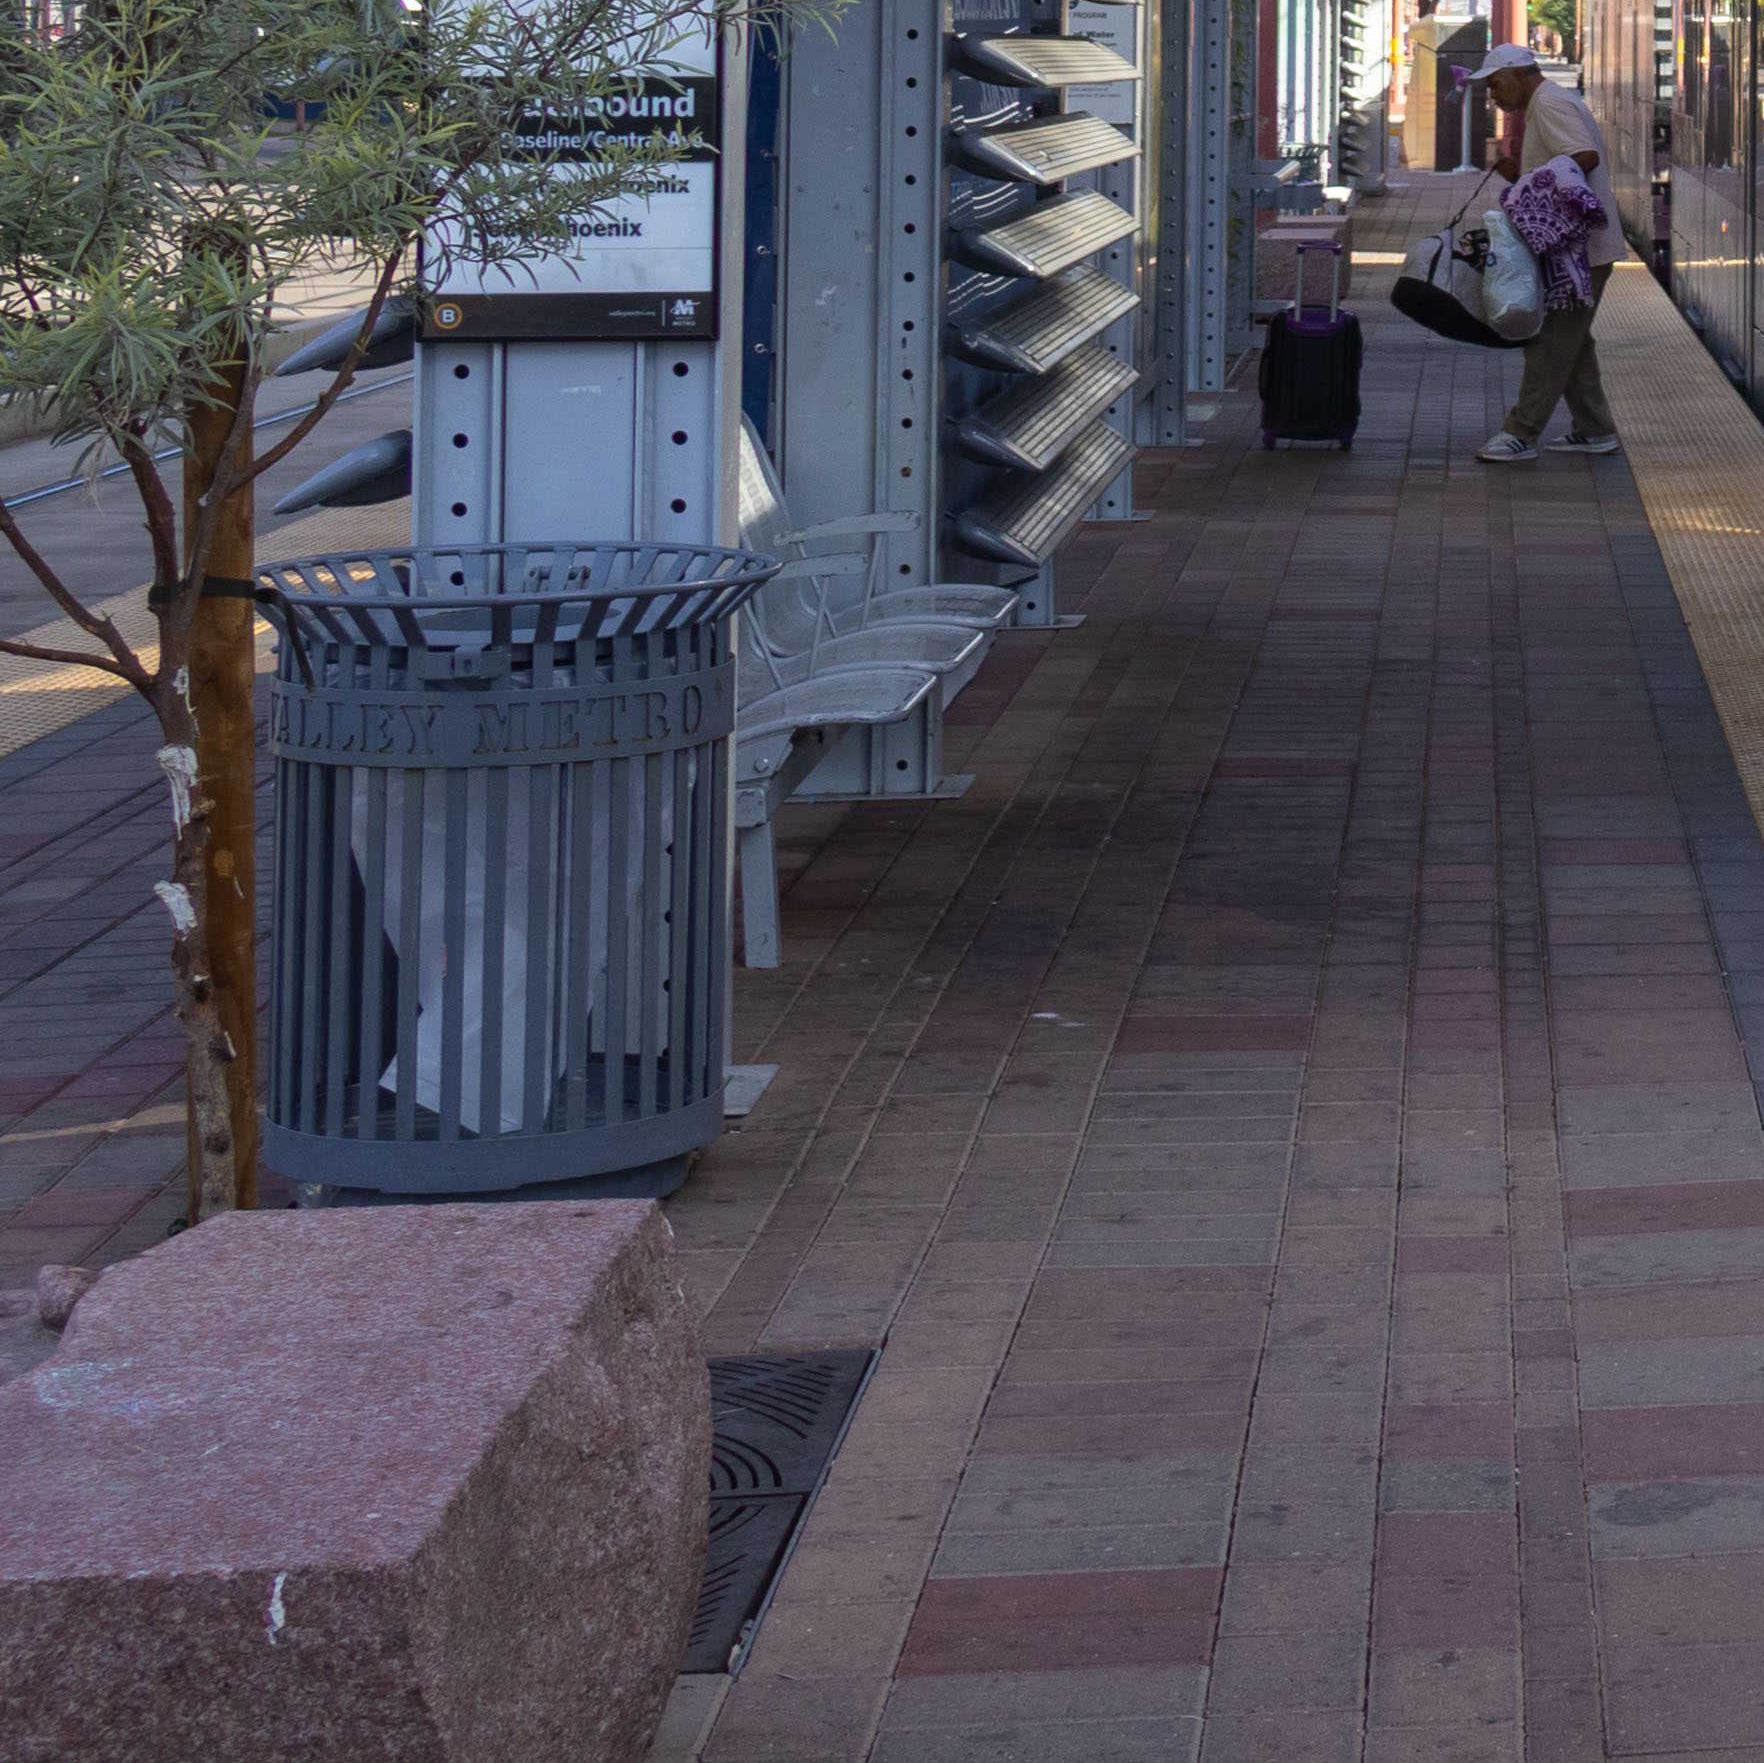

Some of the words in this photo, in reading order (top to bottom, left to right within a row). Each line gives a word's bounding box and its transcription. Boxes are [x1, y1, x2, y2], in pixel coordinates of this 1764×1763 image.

[442, 88, 695, 118] bound
[501, 130, 655, 151] aseline/Centra
[565, 217, 643, 237] hoenix
[473, 685, 701, 754] METRO
